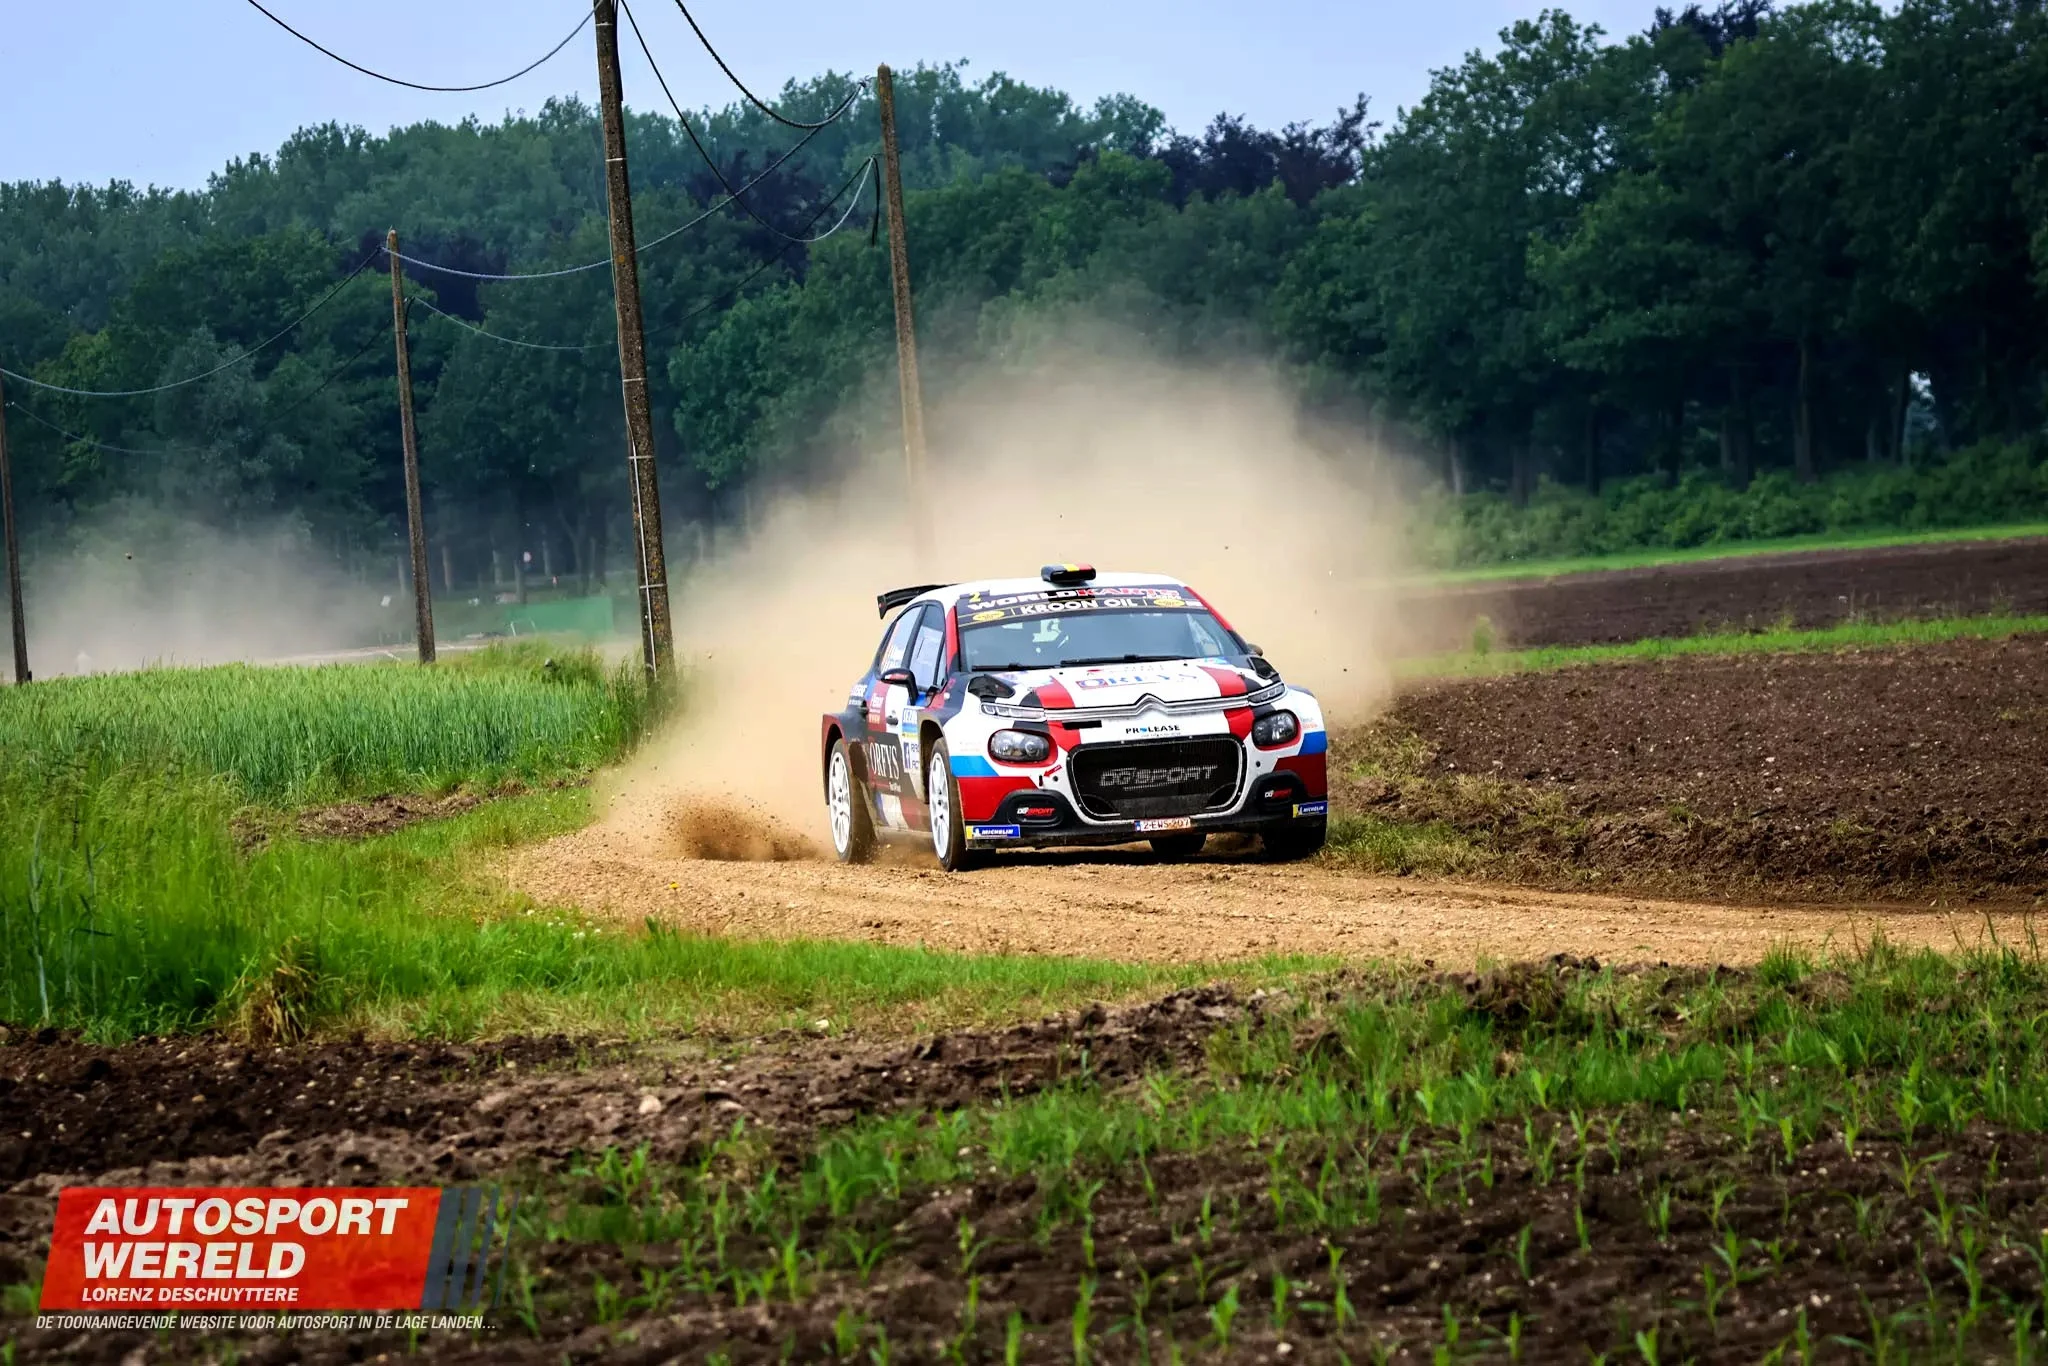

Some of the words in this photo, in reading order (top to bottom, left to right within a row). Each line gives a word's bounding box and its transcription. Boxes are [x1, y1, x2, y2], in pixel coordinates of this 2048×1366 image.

[968, 591, 981, 603] 2
[1020, 600, 1099, 615] KROON
[1104, 598, 1138, 607] OIL
